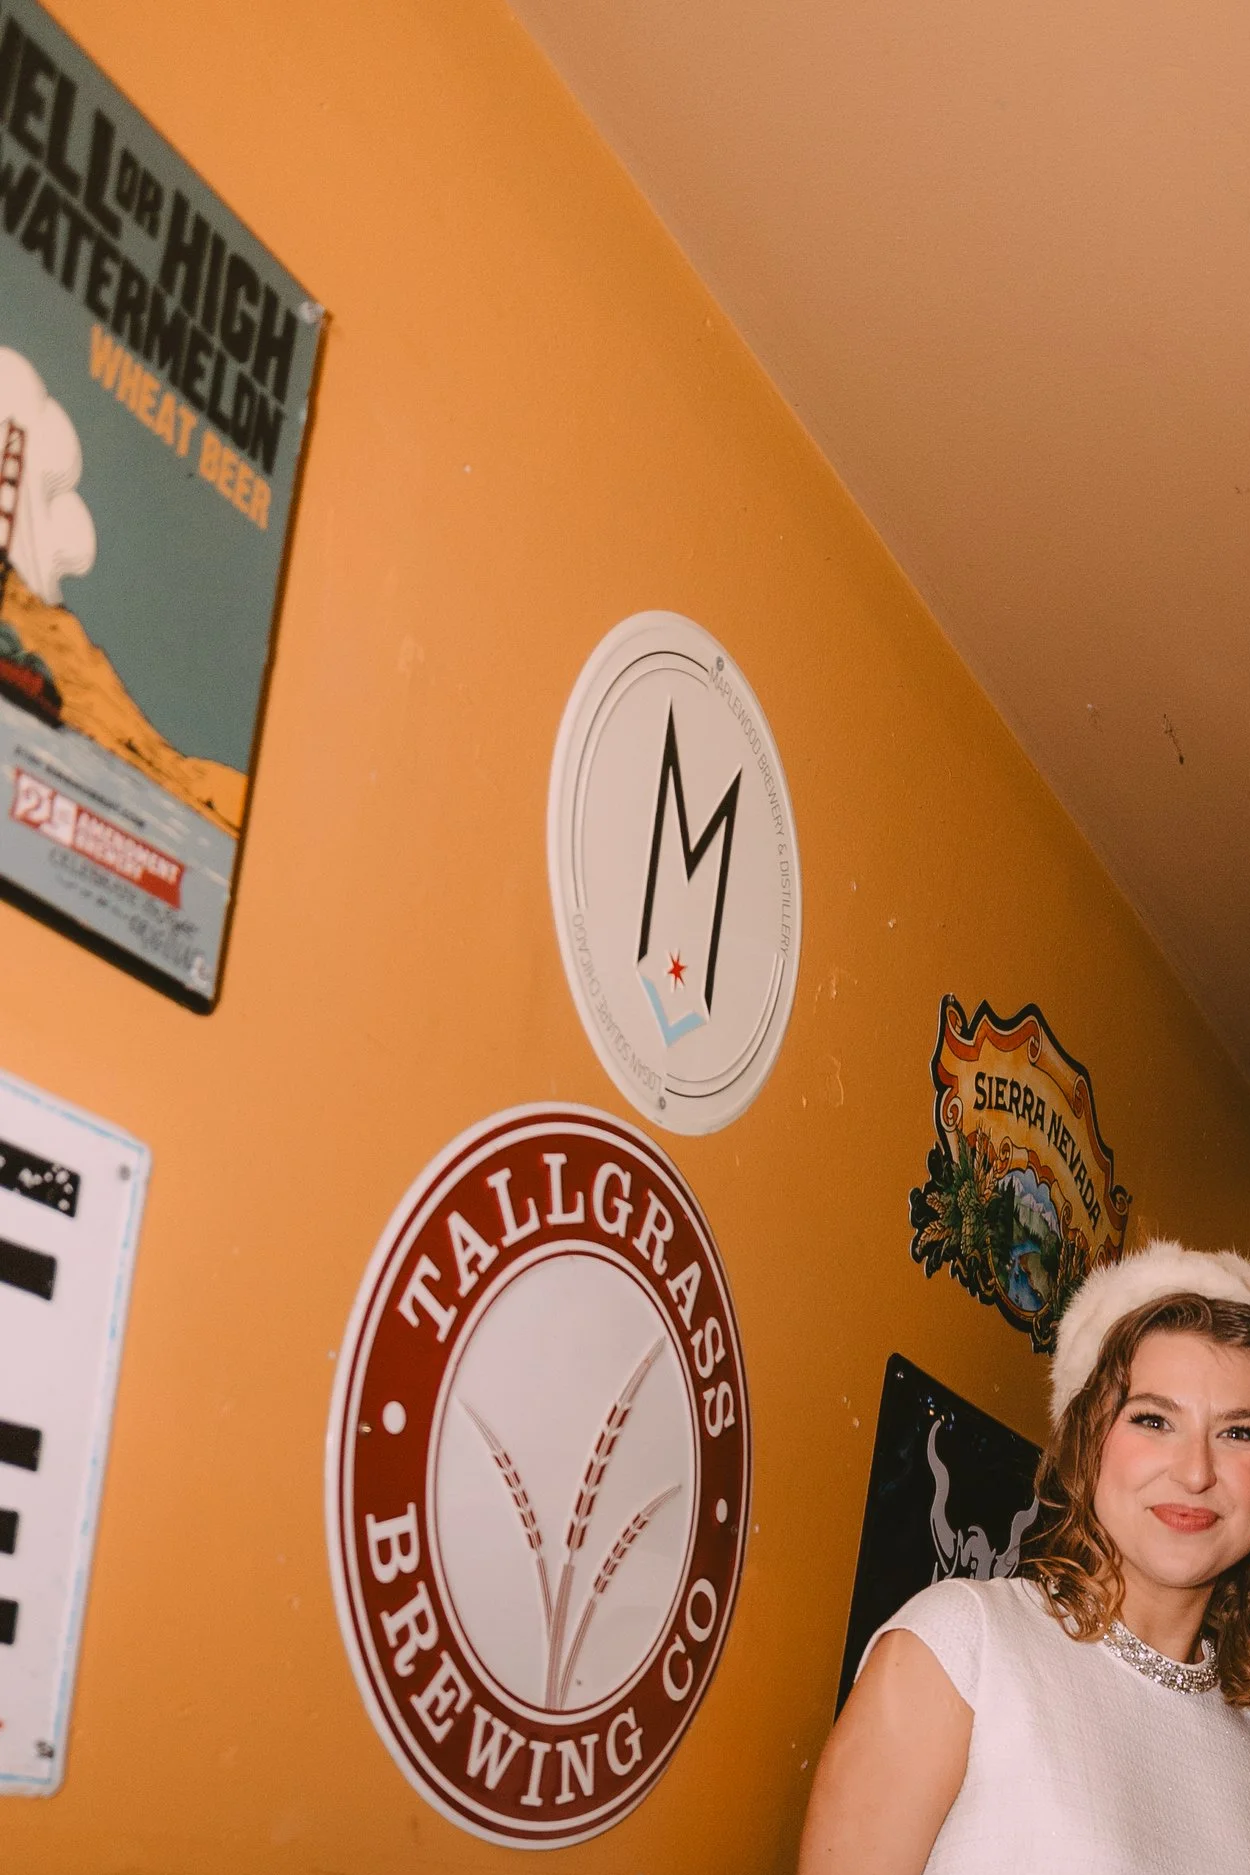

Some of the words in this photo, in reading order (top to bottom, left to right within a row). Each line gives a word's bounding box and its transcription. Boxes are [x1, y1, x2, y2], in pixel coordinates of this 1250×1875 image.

[116, 148, 165, 240] OR
[160, 190, 298, 403] HIGH
[90, 322, 197, 458] WHEAT
[199, 430, 272, 532] BEER
[709, 667, 761, 755] MAPLEWOOD
[757, 753, 785, 836] BREWERY
[778, 843, 787, 855] &
[572, 913, 601, 996] CHICAGO
[779, 860, 791, 957] DISTILLERY
[594, 994, 632, 1061] SQUARE
[629, 1052, 662, 1095] LOGAN
[973, 1071, 1046, 1134] SIERRA
[1047, 1108, 1101, 1233] NEVADA
[399, 1152, 735, 1438] TALLGRASS
[365, 1502, 645, 1807] BREWING
[662, 1577, 718, 1702] CO
